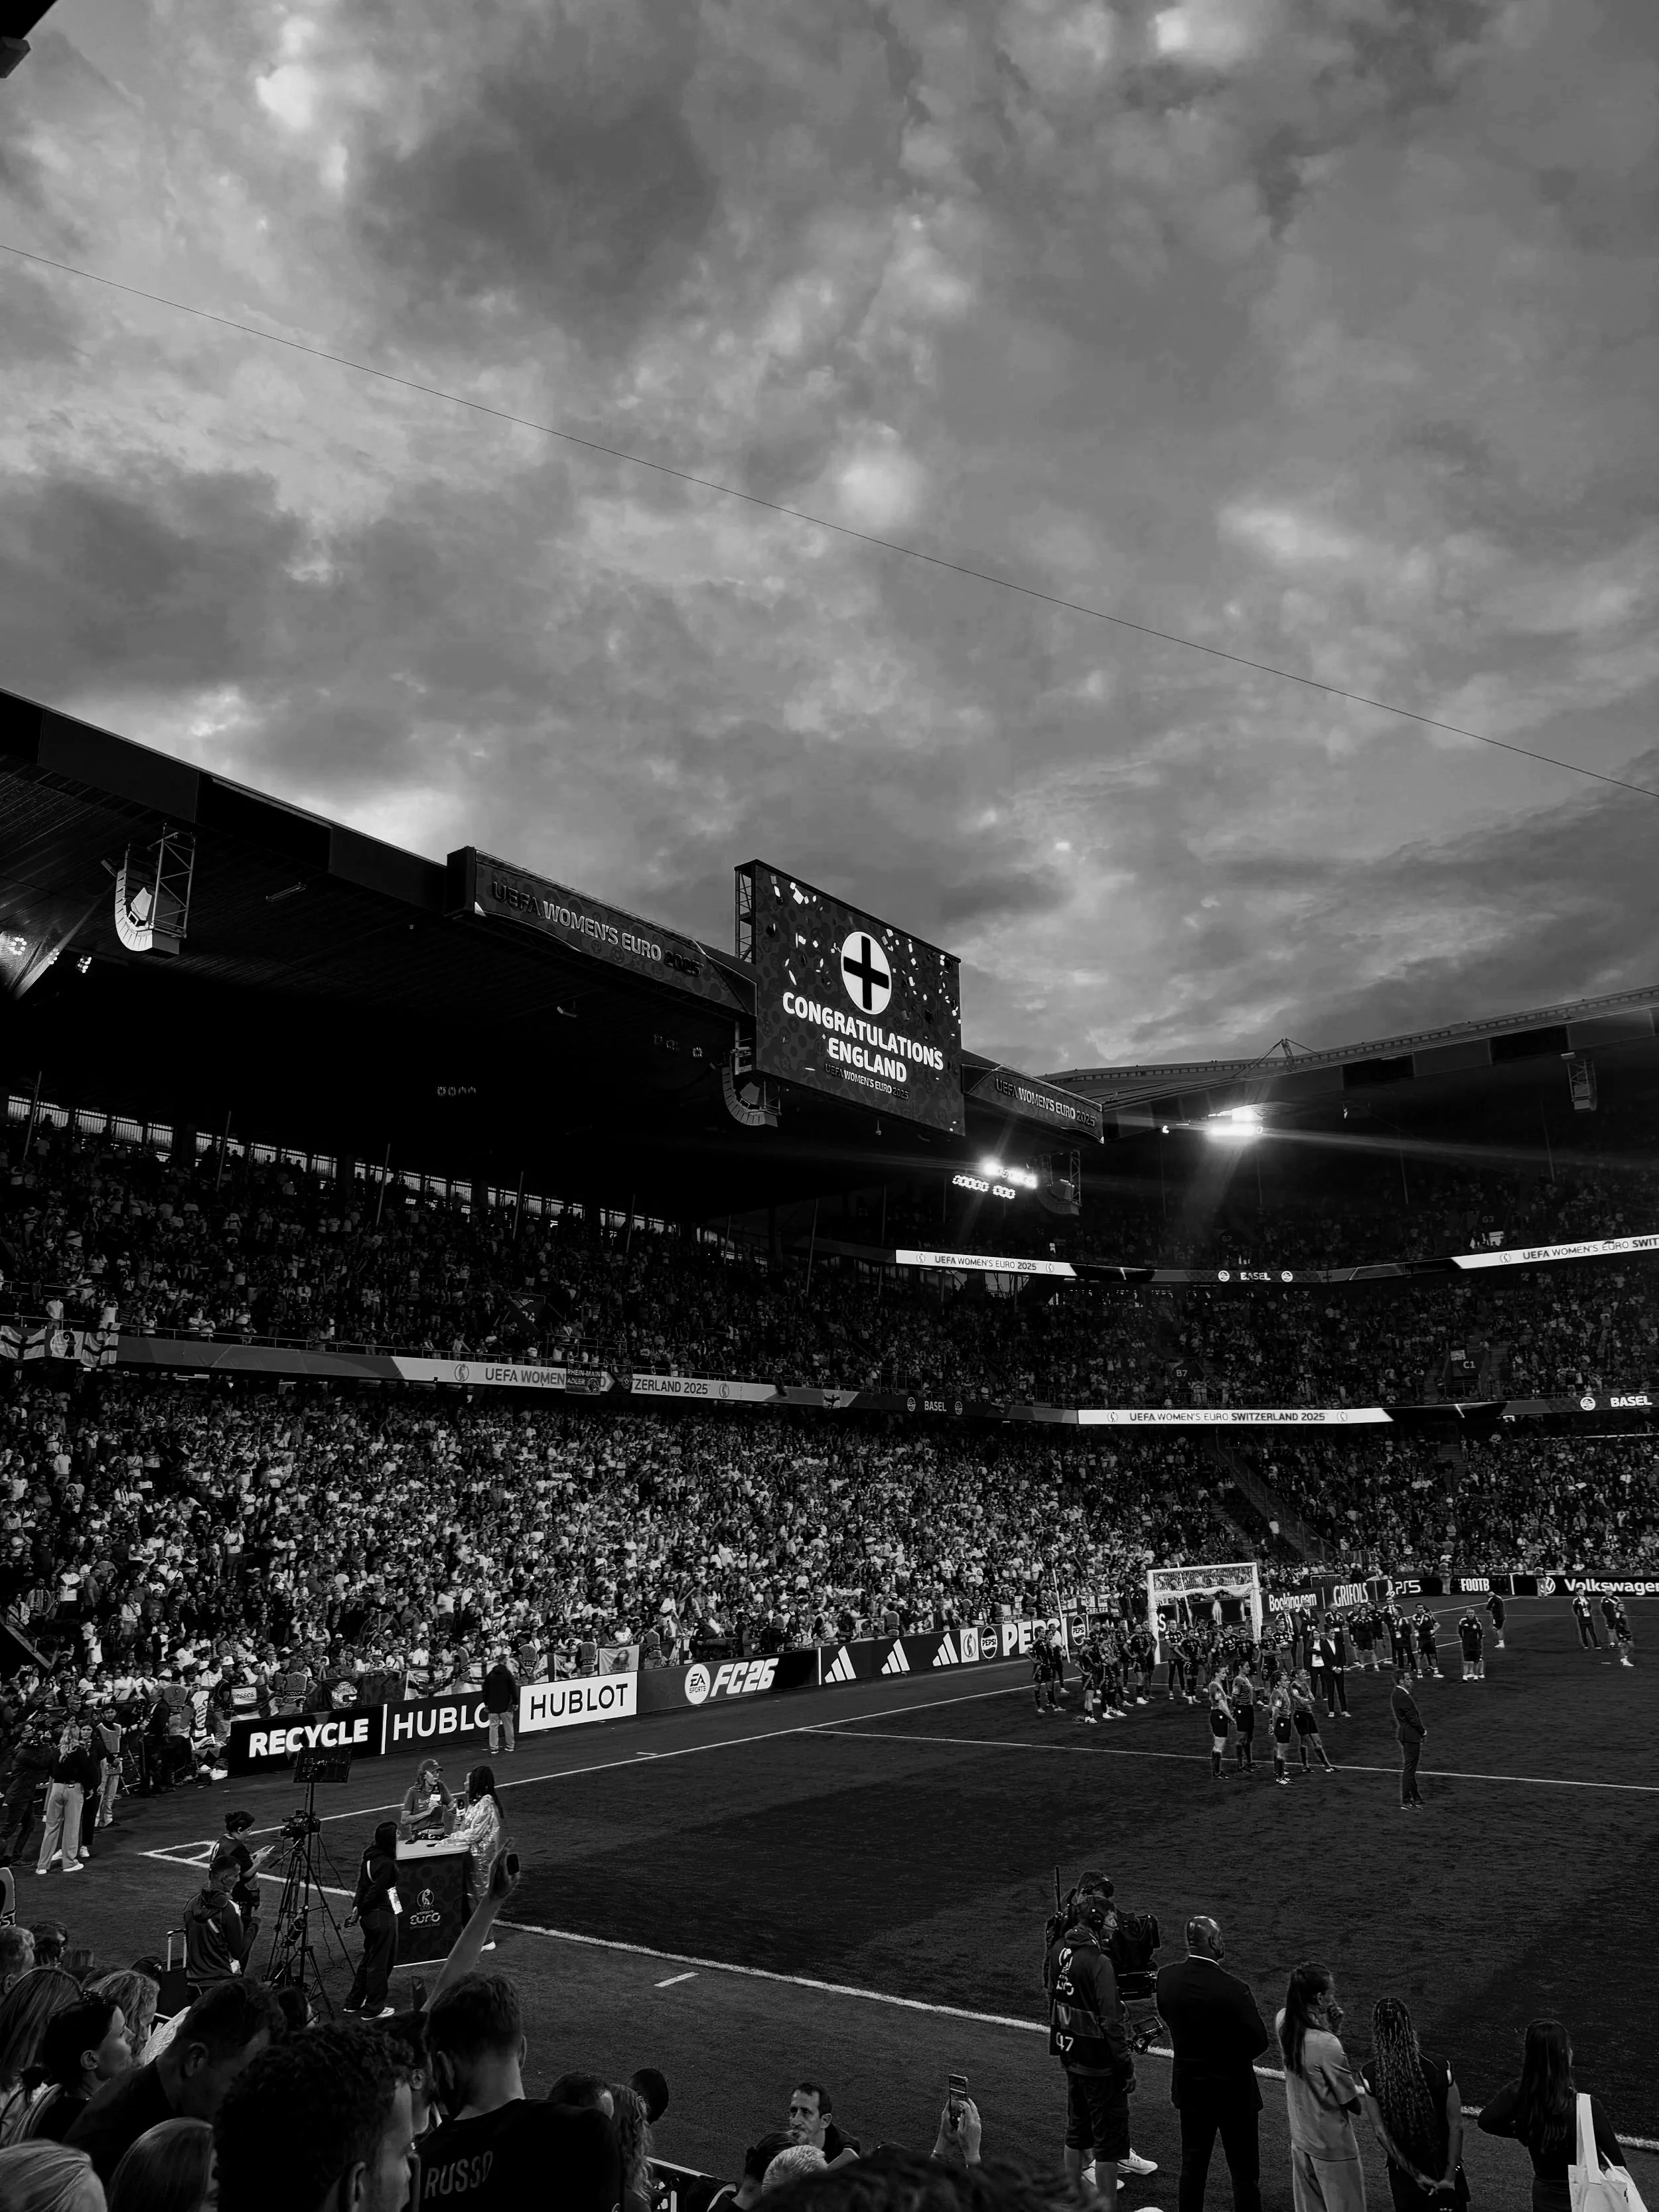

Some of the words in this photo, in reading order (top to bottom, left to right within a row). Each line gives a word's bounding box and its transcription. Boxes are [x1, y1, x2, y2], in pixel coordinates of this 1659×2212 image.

[492, 881, 541, 917] UEFA
[543, 901, 618, 945] WOMEN'S
[621, 932, 662, 961] EURO
[664, 950, 703, 976] 2025
[782, 992, 944, 1070] CONGRATULATIONS
[829, 1037, 906, 1082] ENGLAND
[825, 1063, 843, 1078] UEFA
[844, 1069, 874, 1088] WOMEN'S
[875, 1081, 892, 1093] EURO
[893, 1087, 908, 1099] 2025
[996, 1078, 1018, 1097] UEFA
[1018, 1087, 1054, 1112] WOMEN'S
[1056, 1102, 1075, 1120] EURO
[1076, 1110, 1095, 1126] 2025
[934, 1255, 956, 1264] UEFA
[958, 1258, 993, 1267] WOMEN'S
[995, 1260, 1015, 1269] EURO
[1017, 1262, 1036, 1270] 2025
[1523, 1251, 1550, 1260] UEFA
[1551, 1244, 1599, 1256] WOMEN'S
[1602, 1240, 1628, 1251] EURO
[1240, 1272, 1271, 1281] BASEL
[486, 1368, 518, 1382] UEFA
[521, 1370, 564, 1385] WOMEN
[632, 1378, 681, 1393] ZERLAND
[684, 1382, 708, 1394] 2025
[924, 1400, 947, 1412] BASEL
[1610, 1396, 1653, 1408] BASEL
[1231, 1412, 1299, 1421] SWITZERLAND
[1301, 1412, 1325, 1421] 2025
[1333, 1582, 1369, 1607] GRIFOLS
[690, 1673, 705, 1686] EA
[531, 1683, 628, 1720] HUBLOT
[393, 1702, 490, 1741] HUBLO
[249, 1718, 369, 1759] RECYCLE
[423, 2150, 494, 2199] RUSSO
